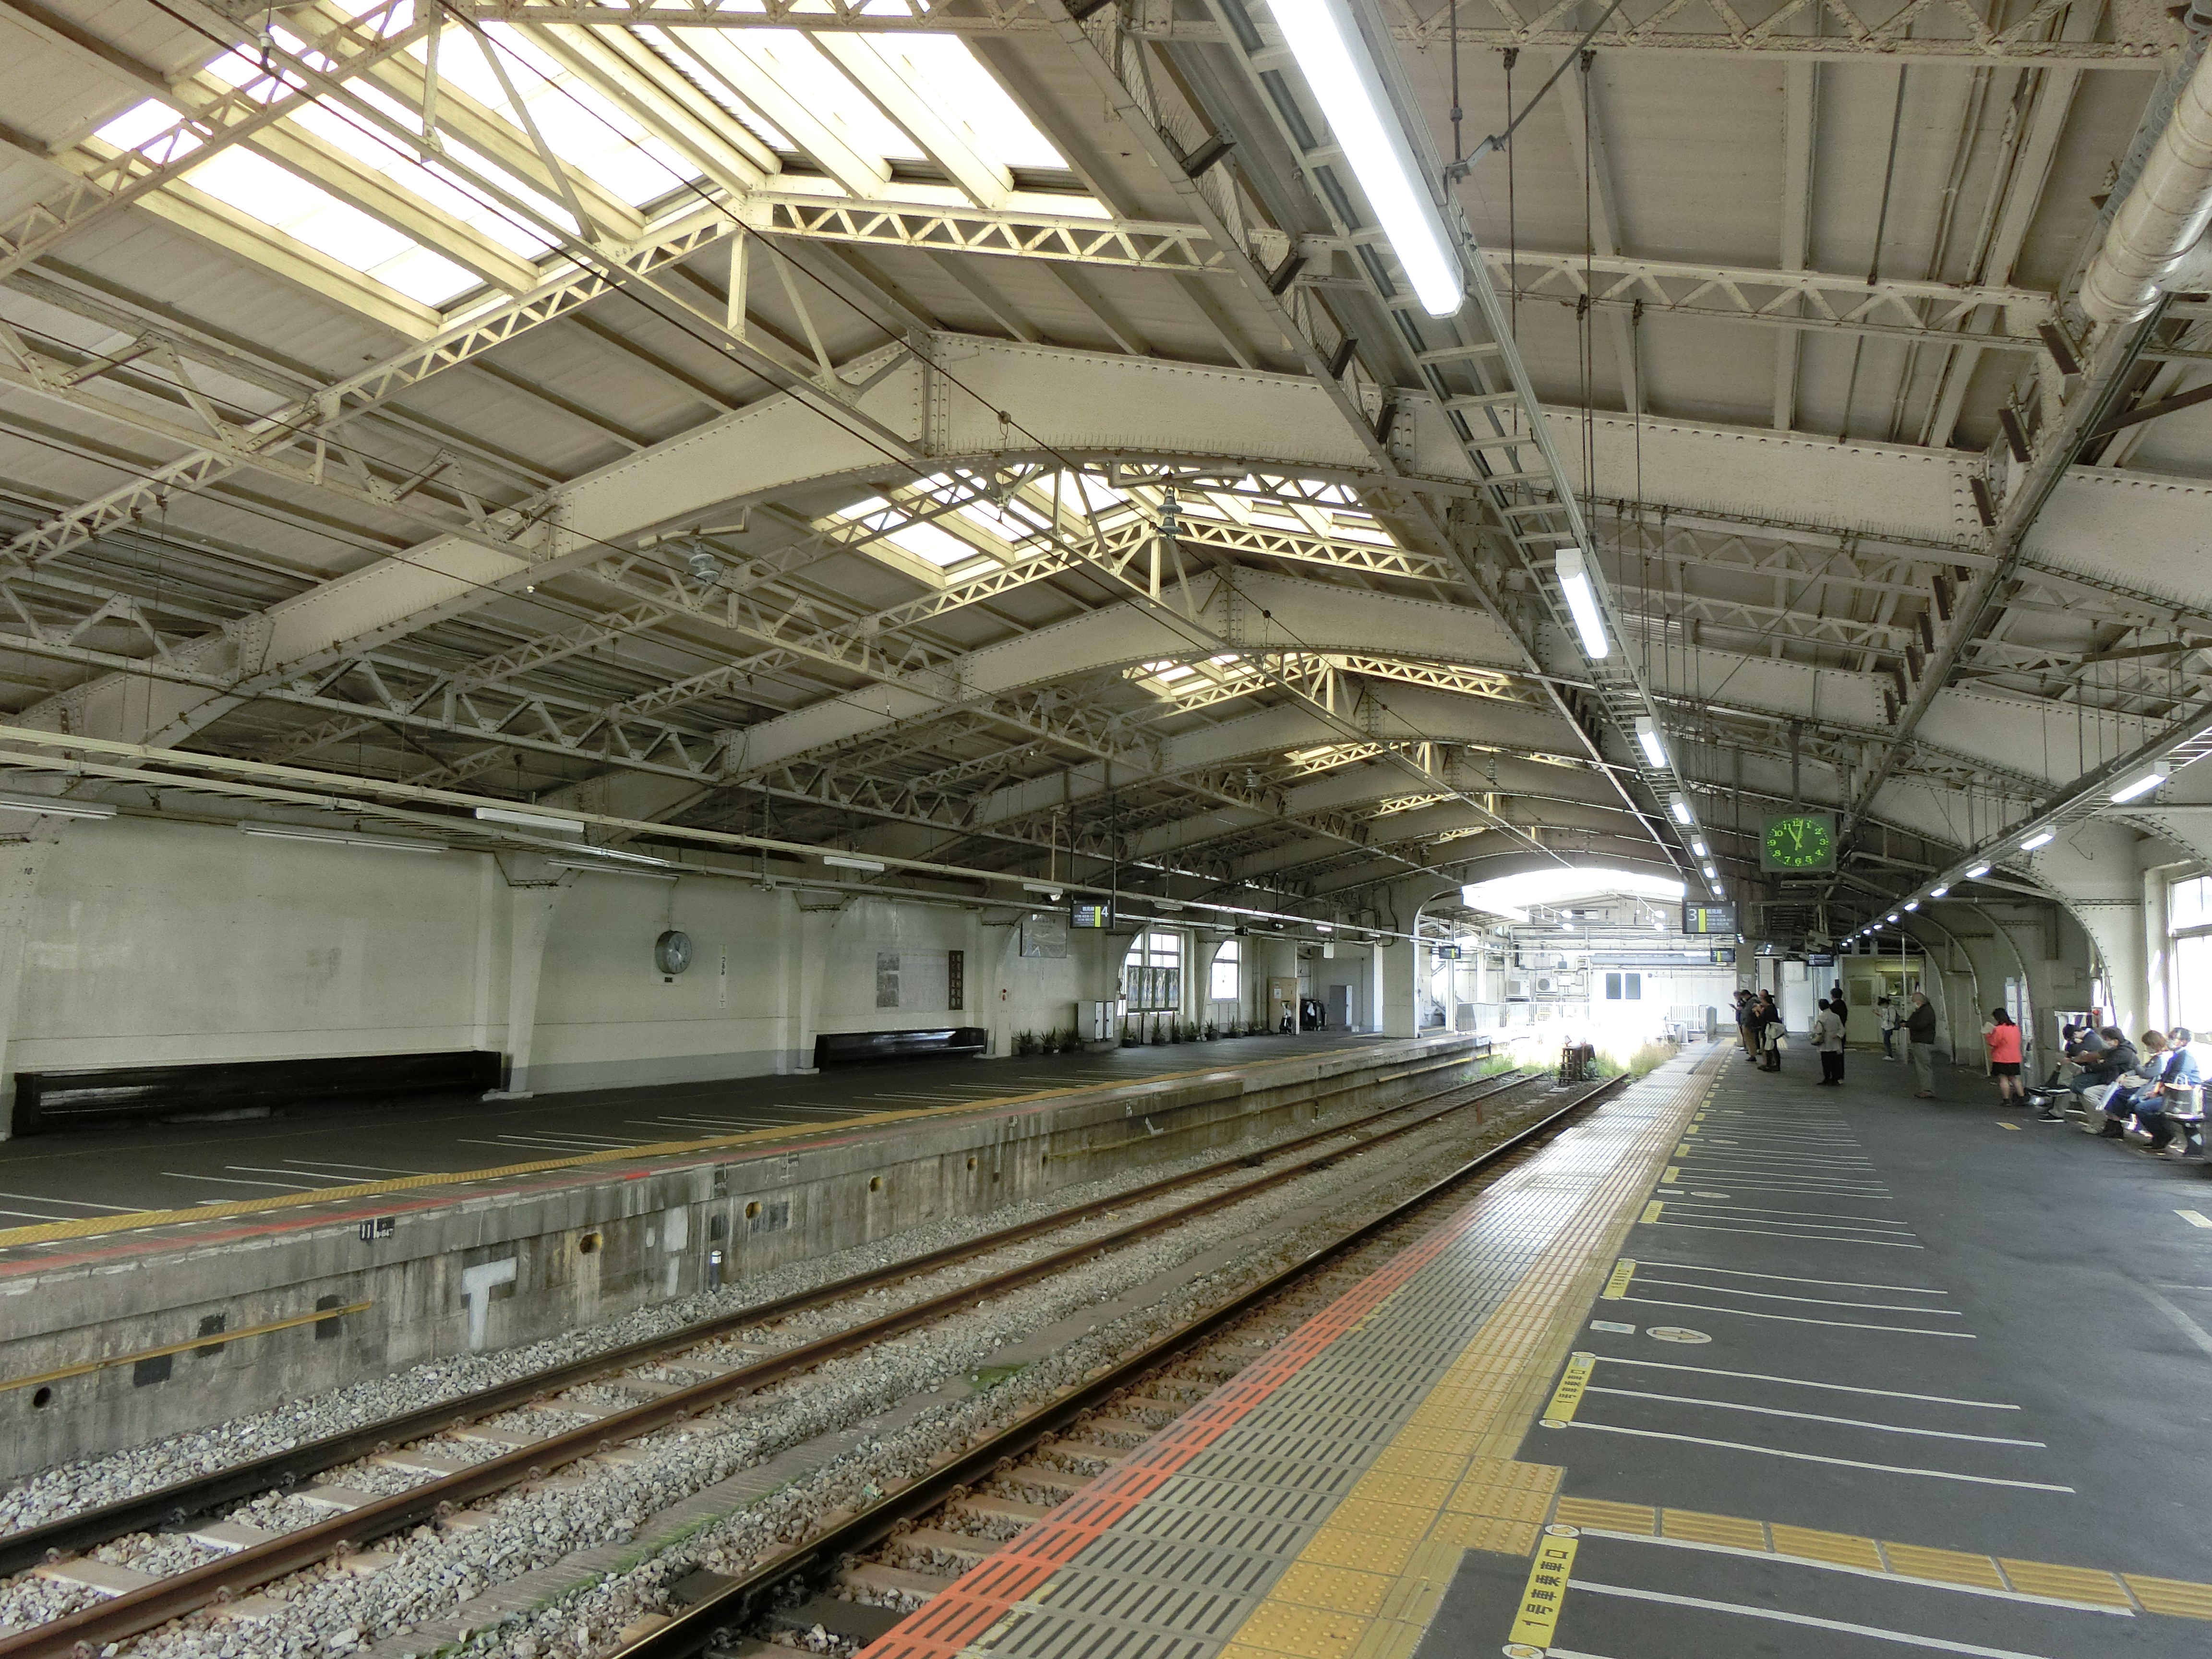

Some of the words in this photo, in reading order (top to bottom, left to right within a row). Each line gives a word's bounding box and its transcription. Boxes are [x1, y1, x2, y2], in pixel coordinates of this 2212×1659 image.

[1101, 906, 1108, 917] 4
[1689, 909, 1697, 921] 3
[1556, 1370, 1586, 1403] 1号車乗車口
[1522, 1549, 1569, 1627] 1号車乗車口
